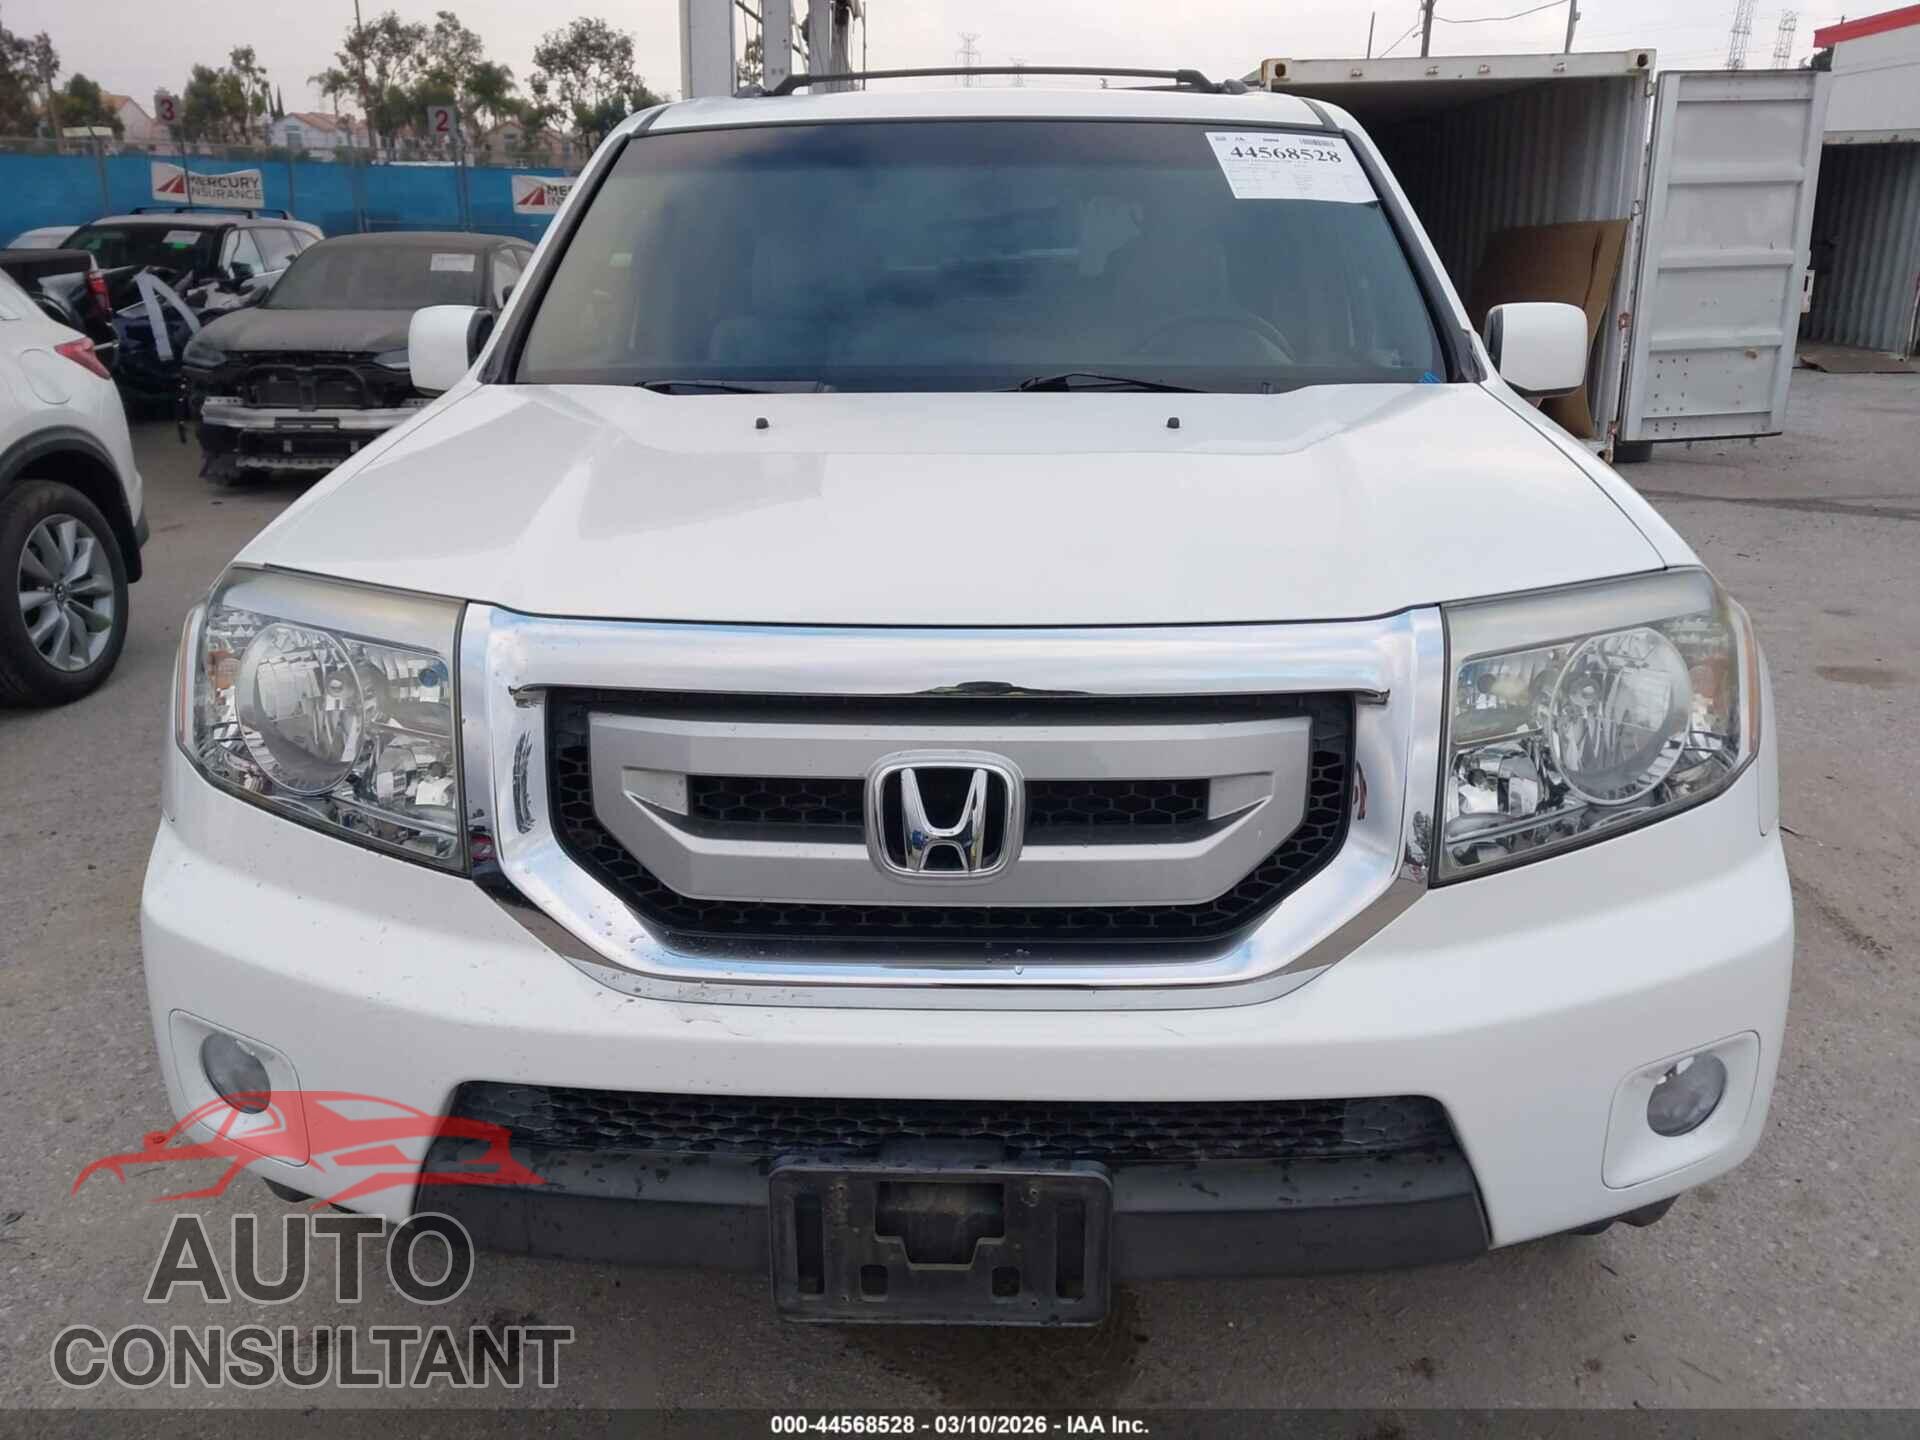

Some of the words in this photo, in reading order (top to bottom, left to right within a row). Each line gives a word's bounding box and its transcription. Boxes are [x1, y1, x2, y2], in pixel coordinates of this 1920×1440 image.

[161, 98, 175, 121] 3
[435, 109, 449, 132] 2
[1230, 146, 1342, 163] 44568528
[187, 186, 262, 200] NSURANCE
